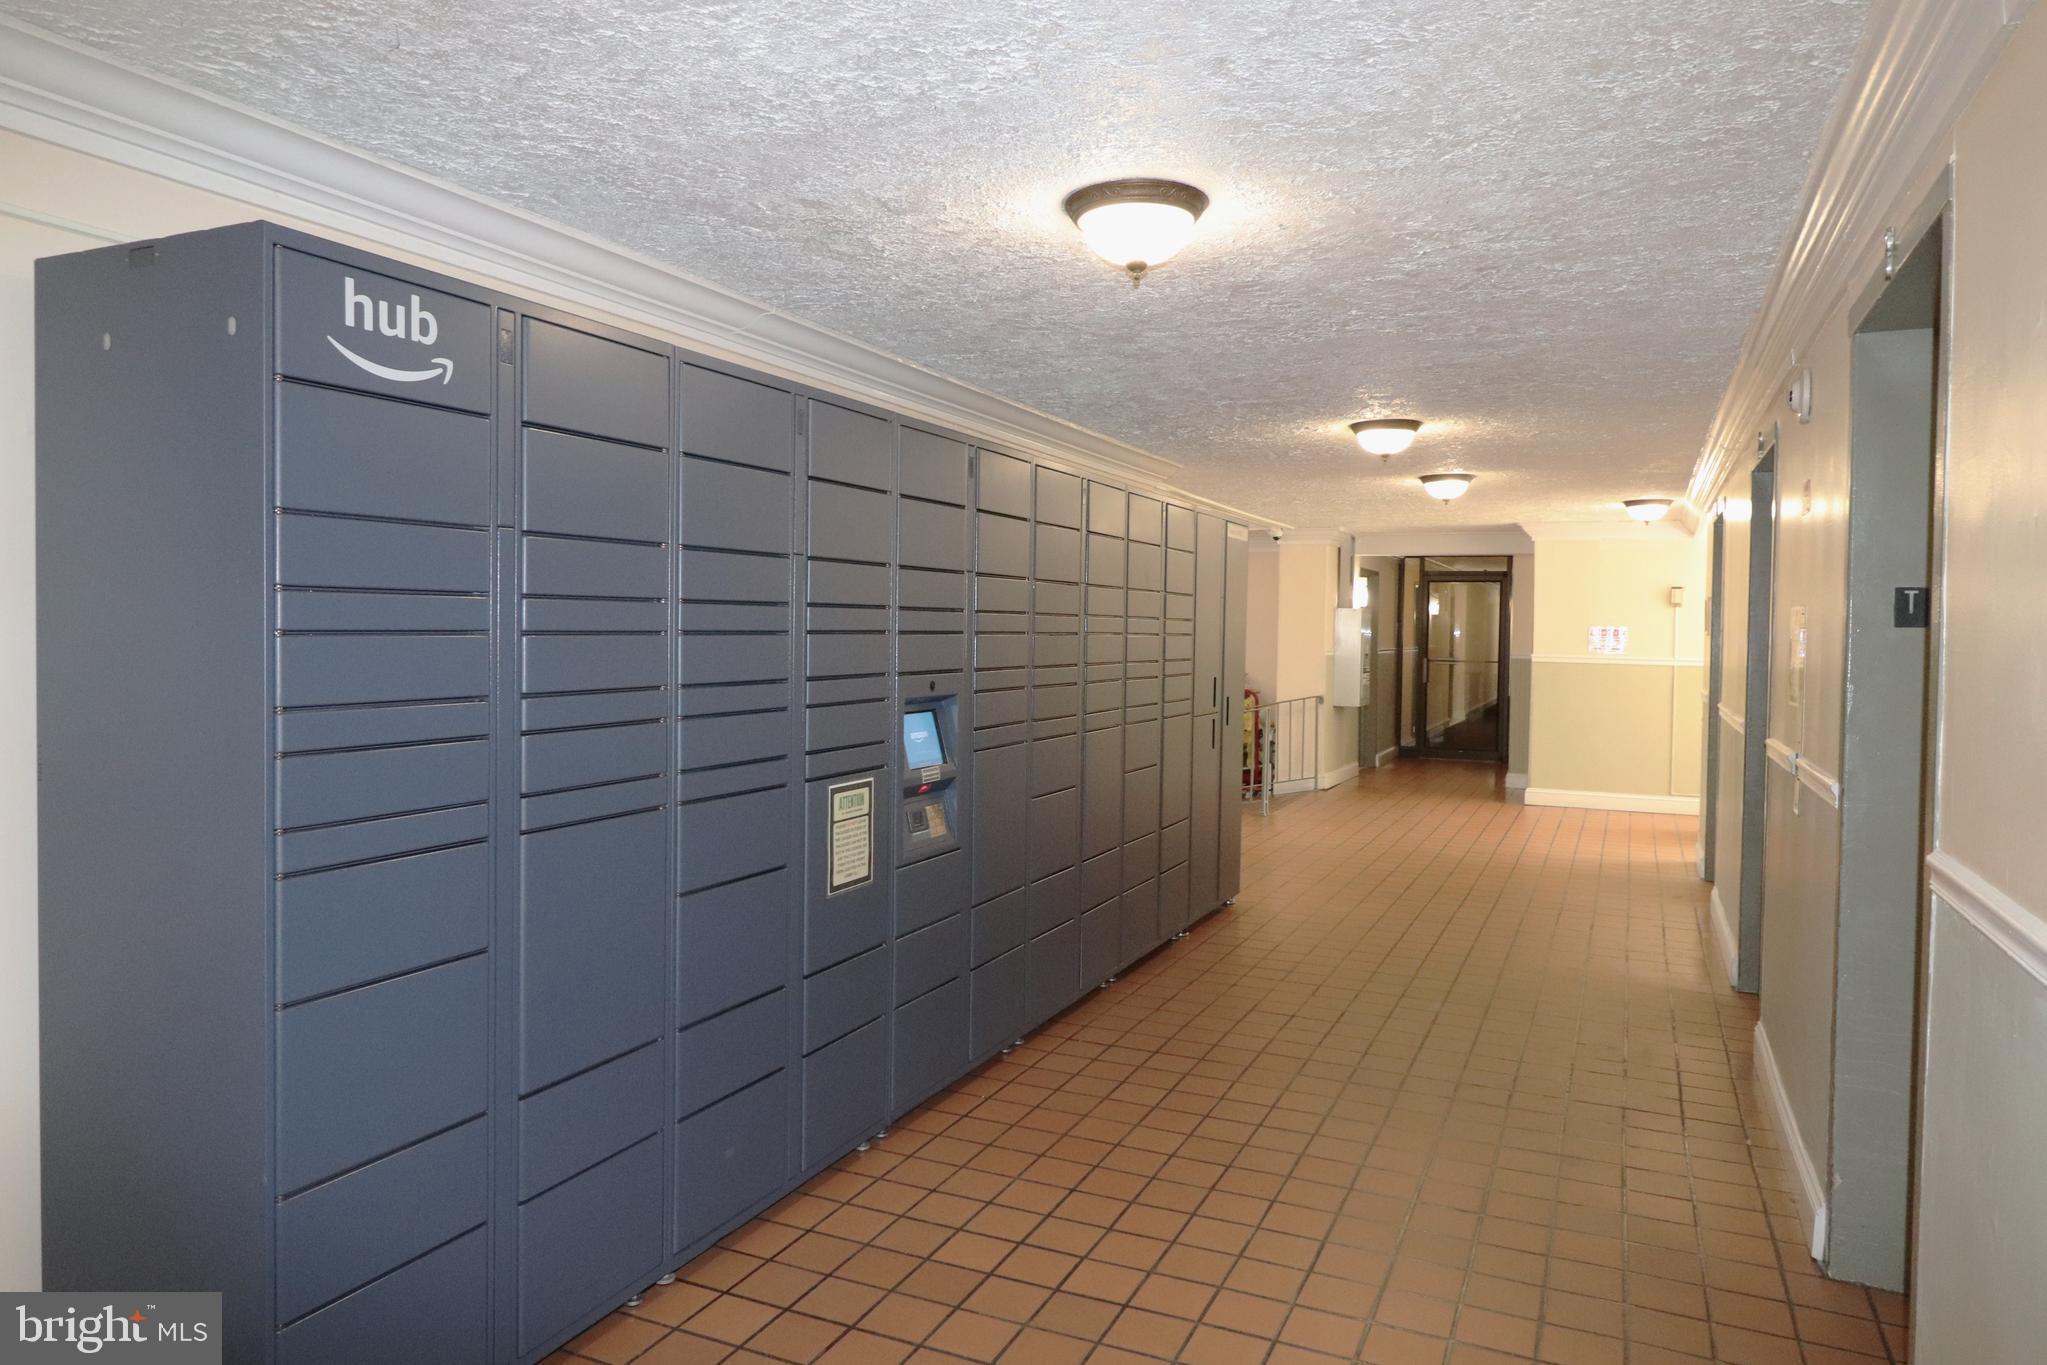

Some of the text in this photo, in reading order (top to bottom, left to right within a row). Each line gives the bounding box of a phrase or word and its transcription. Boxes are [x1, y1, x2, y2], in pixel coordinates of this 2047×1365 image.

[345, 277, 438, 345] hub
[1904, 590, 1919, 614] T
[839, 792, 865, 810] ATTENTION
